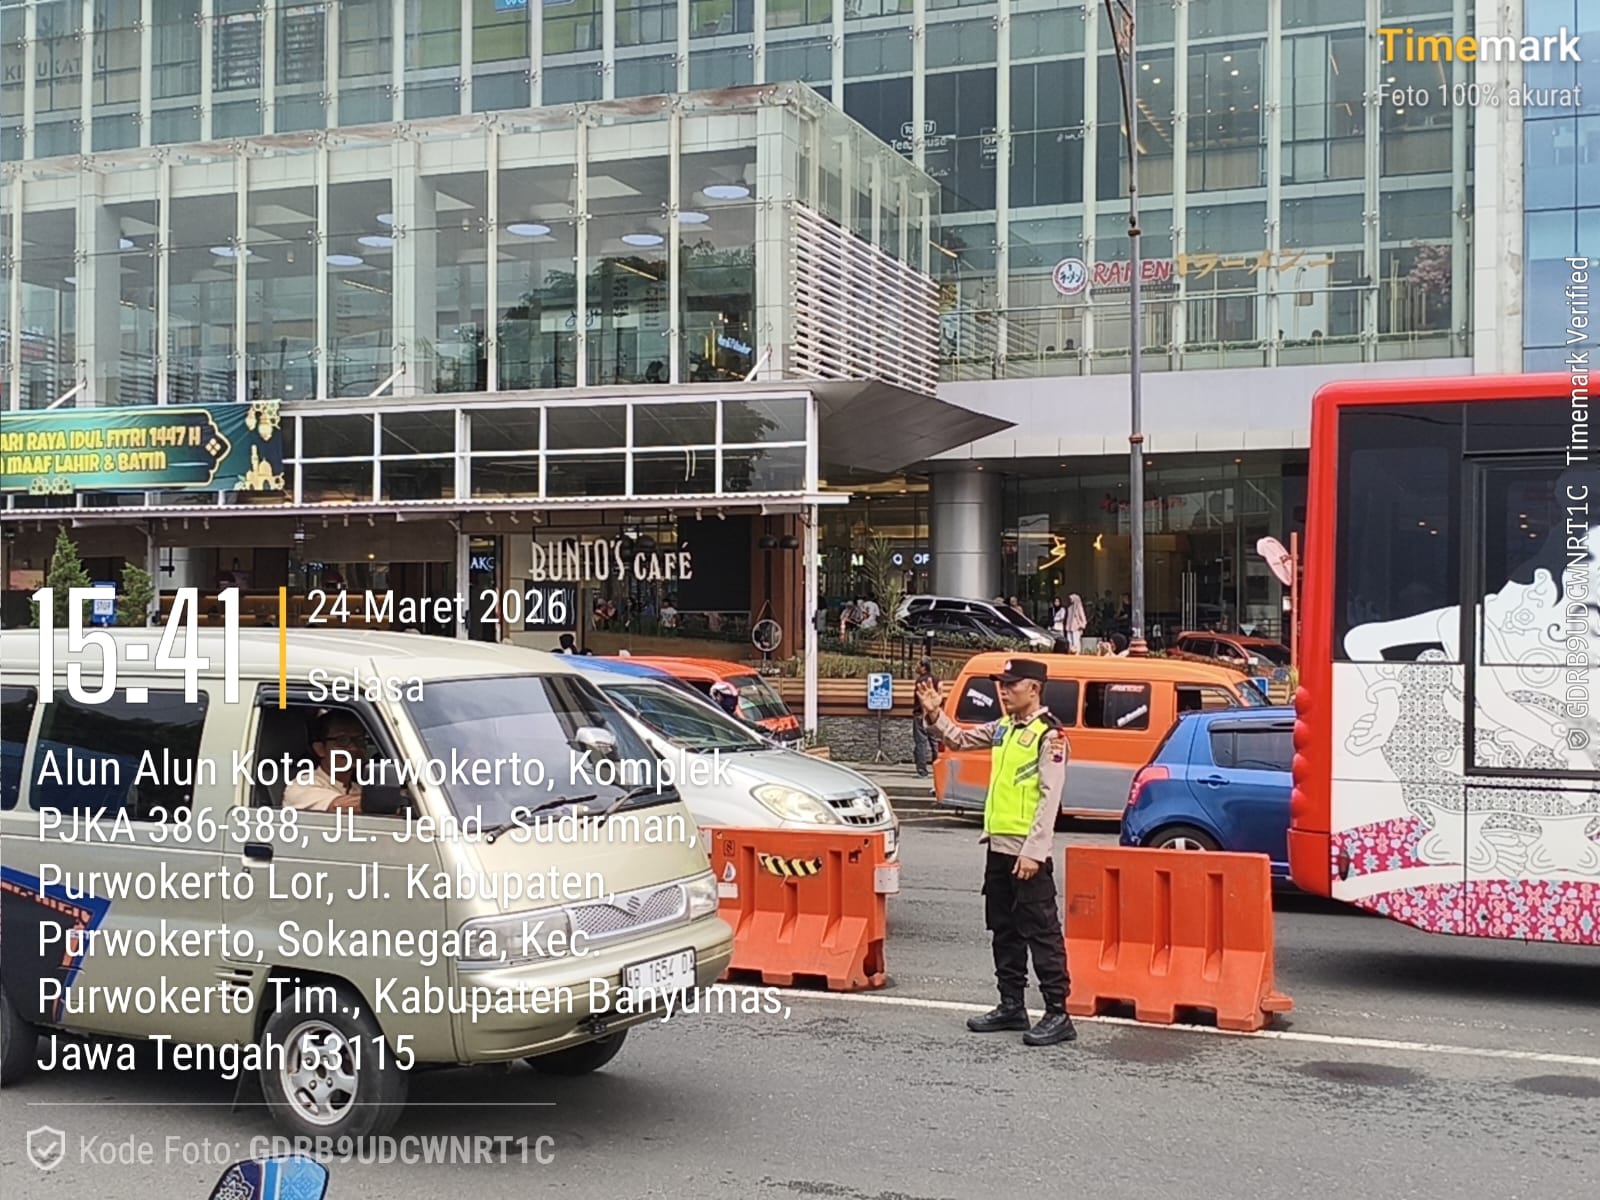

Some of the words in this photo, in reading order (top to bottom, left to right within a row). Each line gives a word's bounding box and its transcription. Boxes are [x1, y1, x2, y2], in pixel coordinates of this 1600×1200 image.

[27, 431, 66, 450] RAYA
[70, 430, 103, 449] IDUL
[107, 428, 146, 448] FITRI
[149, 426, 186, 447] 1447
[189, 426, 201, 446] H
[7, 455, 52, 474] MAAF
[55, 453, 100, 472] LAHIR
[104, 454, 114, 471] &
[118, 451, 166, 472] BATIN
[528, 539, 626, 582] BUNTO'S
[633, 541, 693, 581] CAFÉ
